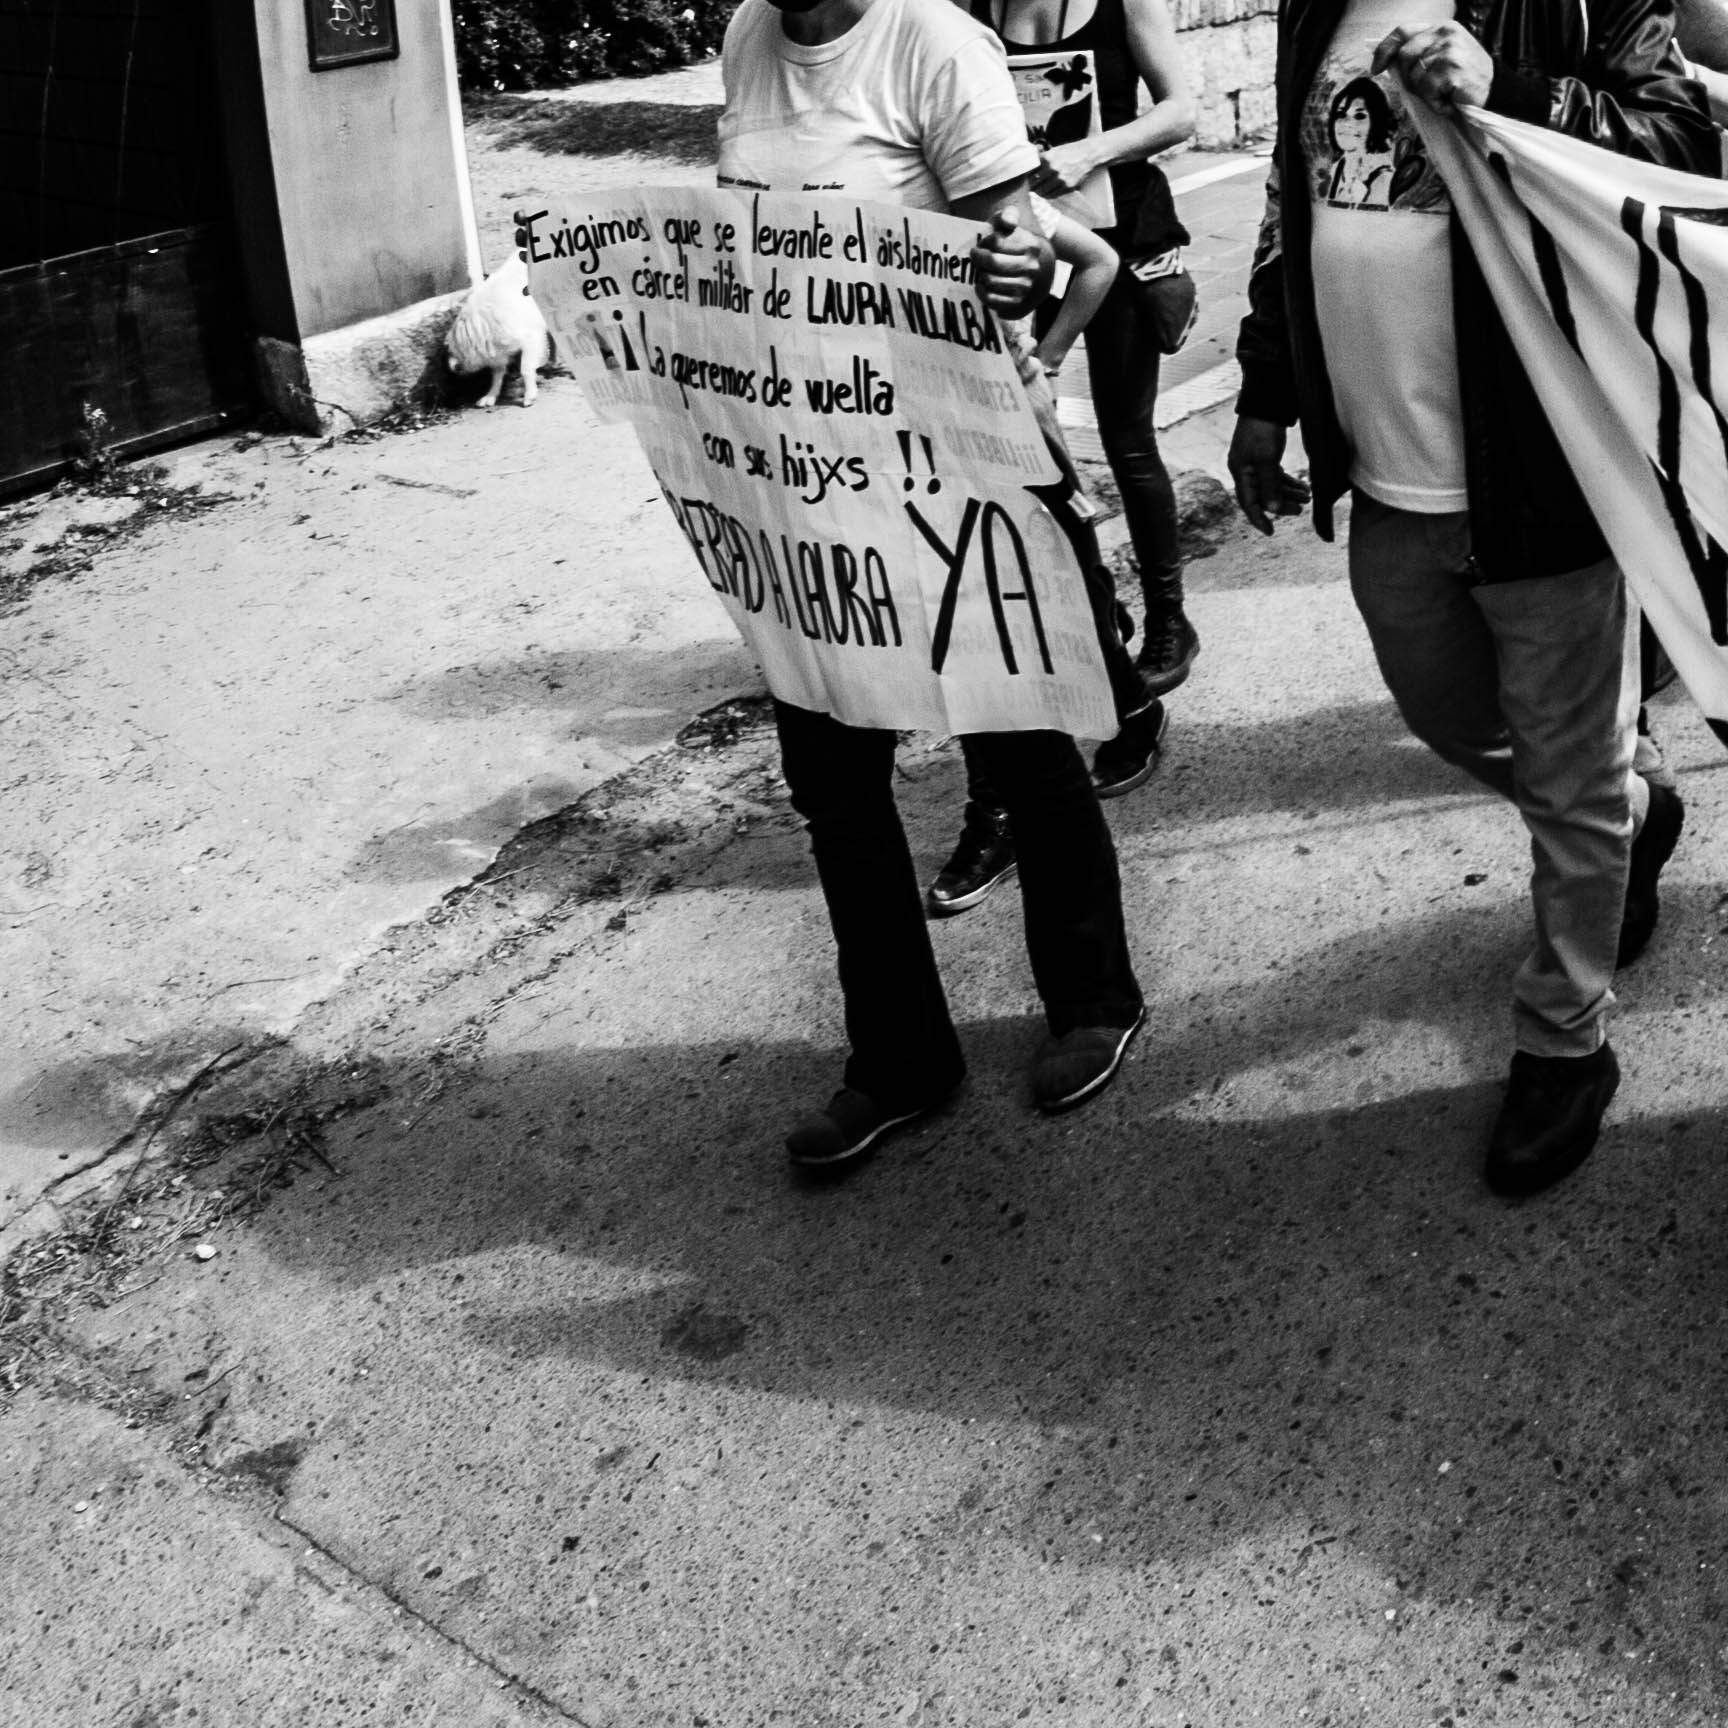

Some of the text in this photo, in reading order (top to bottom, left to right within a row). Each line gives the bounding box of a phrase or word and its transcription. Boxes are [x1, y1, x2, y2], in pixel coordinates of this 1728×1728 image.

[527, 209, 650, 274] Exigimos
[664, 218, 703, 267] que
[713, 222, 736, 253] se
[752, 192, 833, 260] levante
[843, 205, 867, 264] el
[582, 275, 621, 301] en
[698, 259, 754, 314] militar
[762, 267, 793, 320] de
[806, 275, 896, 329] LAURA
[897, 286, 1003, 355] VILLALBA
[671, 352, 758, 410] queremos
[761, 344, 793, 408] de
[702, 431, 736, 470] con
[779, 433, 870, 505] hijxs
[759, 528, 792, 630] A
[780, 533, 902, 648] LAURA
[903, 496, 1055, 675] YA
